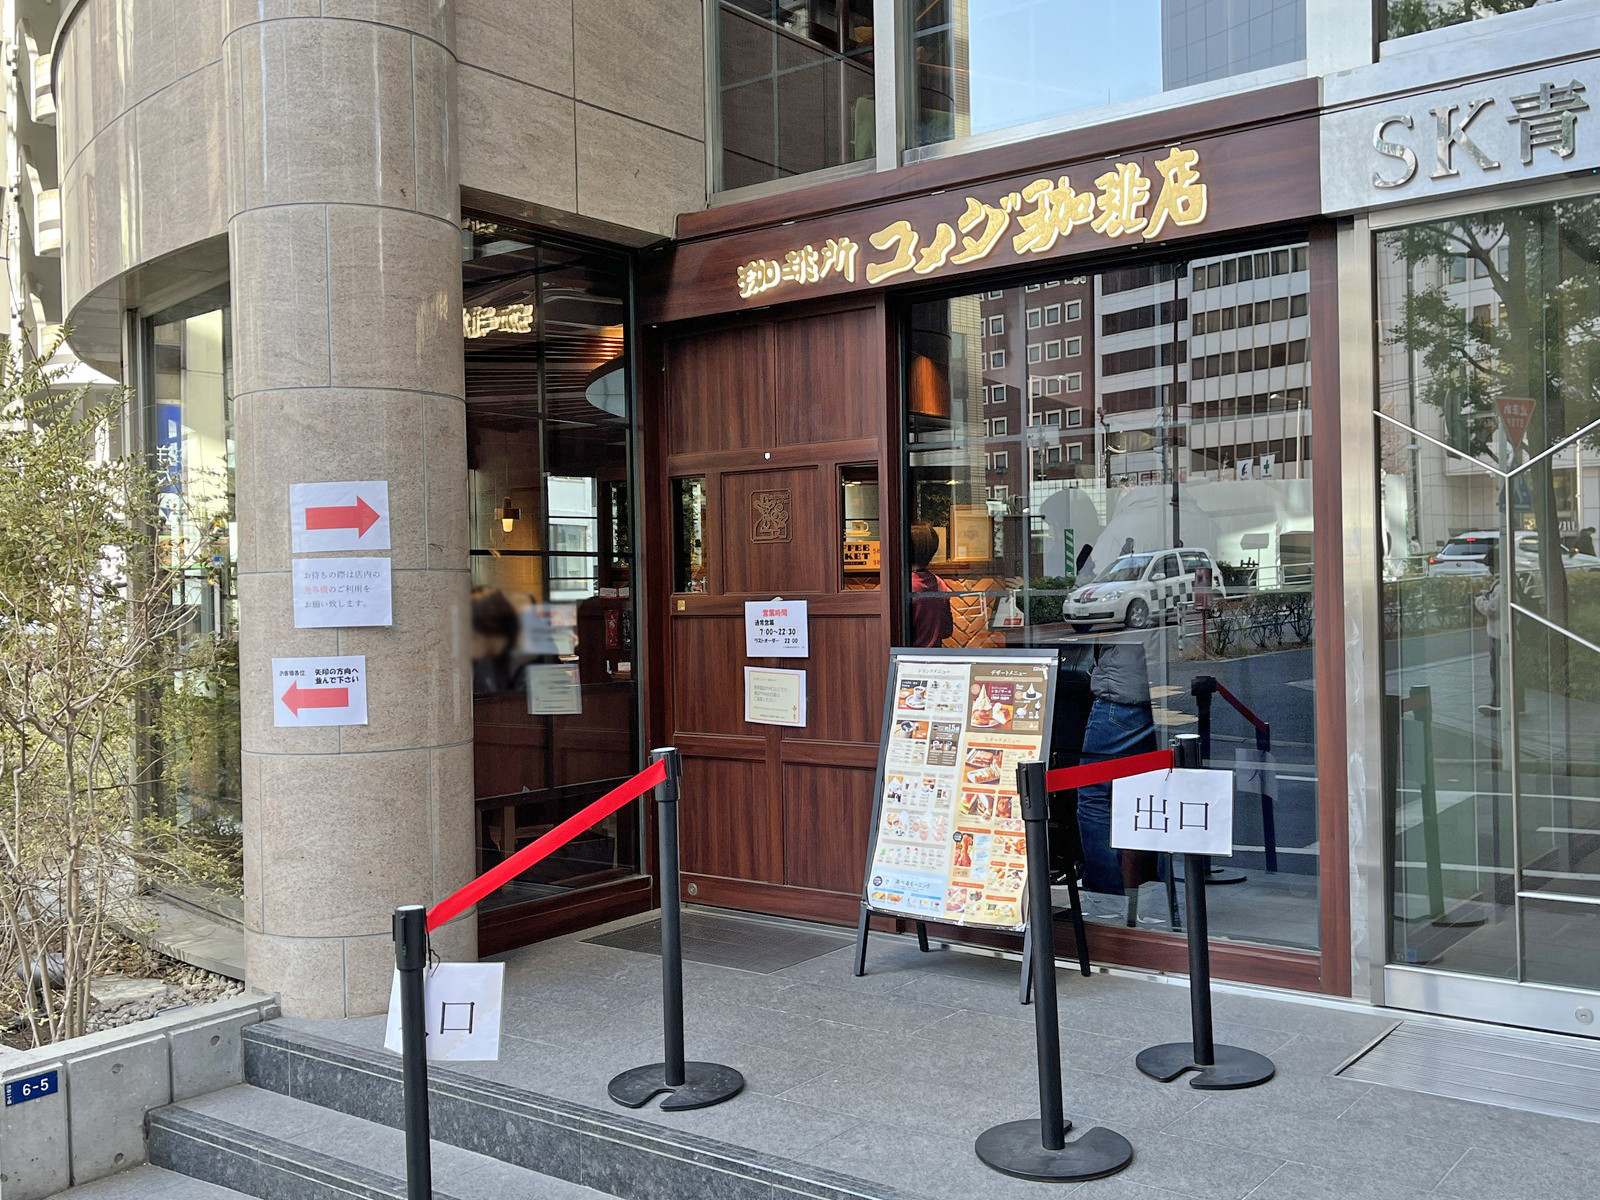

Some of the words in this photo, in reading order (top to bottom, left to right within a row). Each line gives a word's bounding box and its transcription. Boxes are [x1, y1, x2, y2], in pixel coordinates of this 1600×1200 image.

[304, 570, 381, 580] お待ちの際は店内の
[762, 608, 788, 617] 営業時間
[314, 667, 359, 676] 矢印の方向へ
[1134, 794, 1209, 833] 出口
[22, 1077, 49, 1096] 6-5
